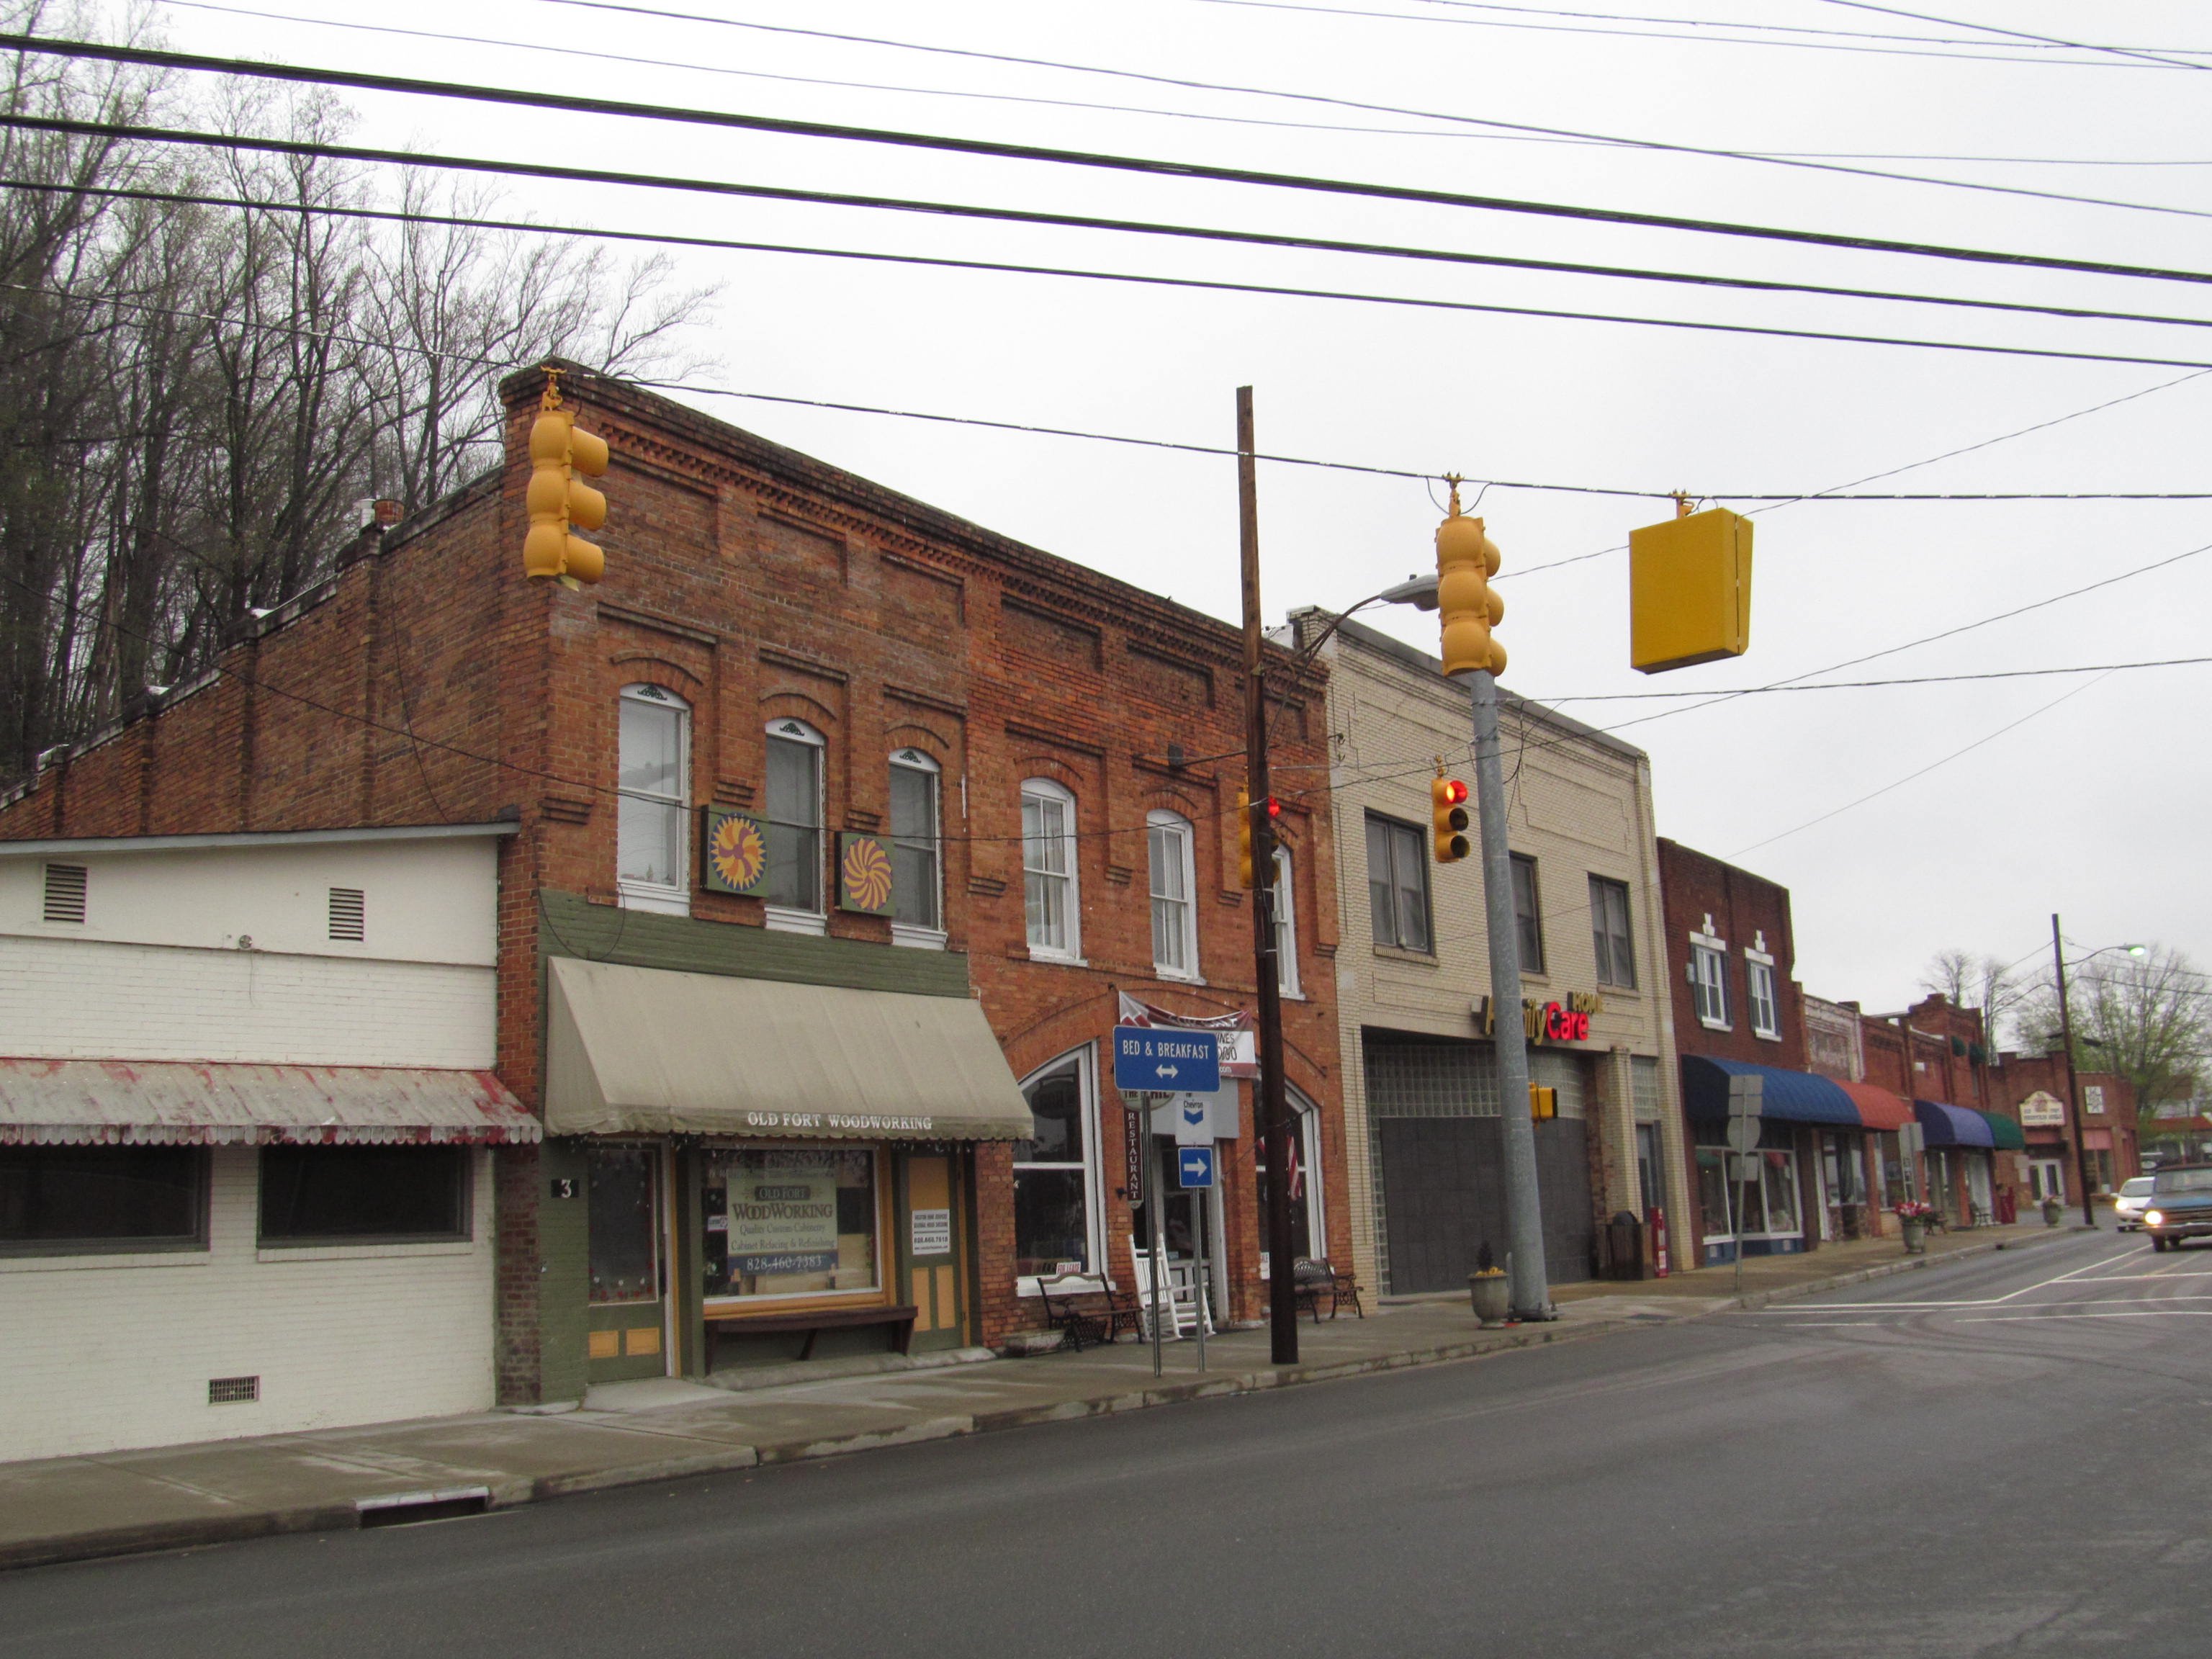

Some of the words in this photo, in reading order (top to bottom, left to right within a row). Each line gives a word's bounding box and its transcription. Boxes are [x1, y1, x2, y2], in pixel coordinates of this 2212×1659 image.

[1123, 1040, 1140, 1055] BED
[1145, 1041, 1153, 1056] &
[1157, 1042, 1209, 1059] BREAKFAST
[1183, 1100, 1204, 1109] Chevron
[748, 1112, 778, 1127] OLD
[782, 1113, 821, 1128] FORT
[828, 1115, 932, 1130] WOODWORKING
[1128, 1112, 1138, 1199] RESTAURANT
[560, 1179, 572, 1198] 3
[759, 1187, 780, 1199] OLD
